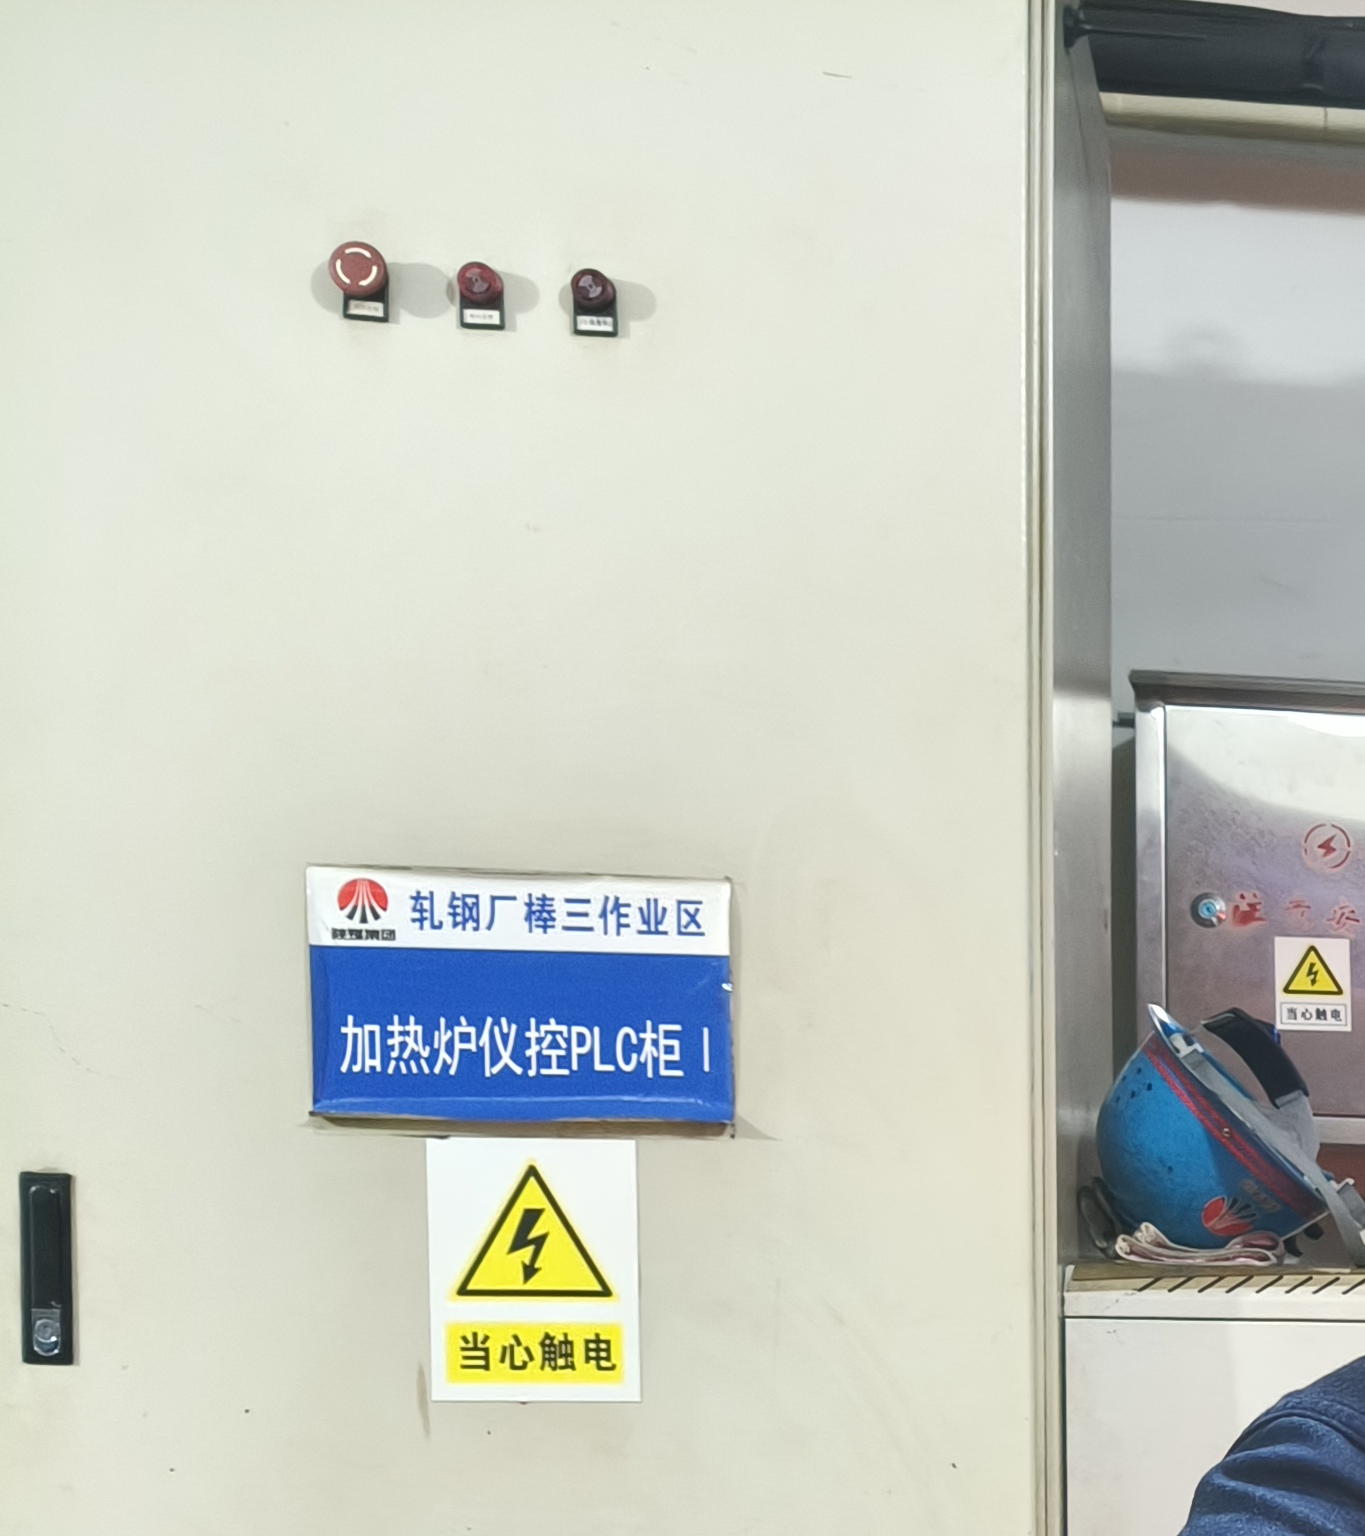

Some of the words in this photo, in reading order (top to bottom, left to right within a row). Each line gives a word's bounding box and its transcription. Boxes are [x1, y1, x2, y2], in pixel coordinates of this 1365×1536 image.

[409, 889, 706, 937] 轧钢厂棒三作业区
[1286, 1007, 1343, 1023] 当心触电
[340, 1014, 684, 1078] 加热炉仪控PLC柜
[459, 1332, 616, 1372] 当心触电
